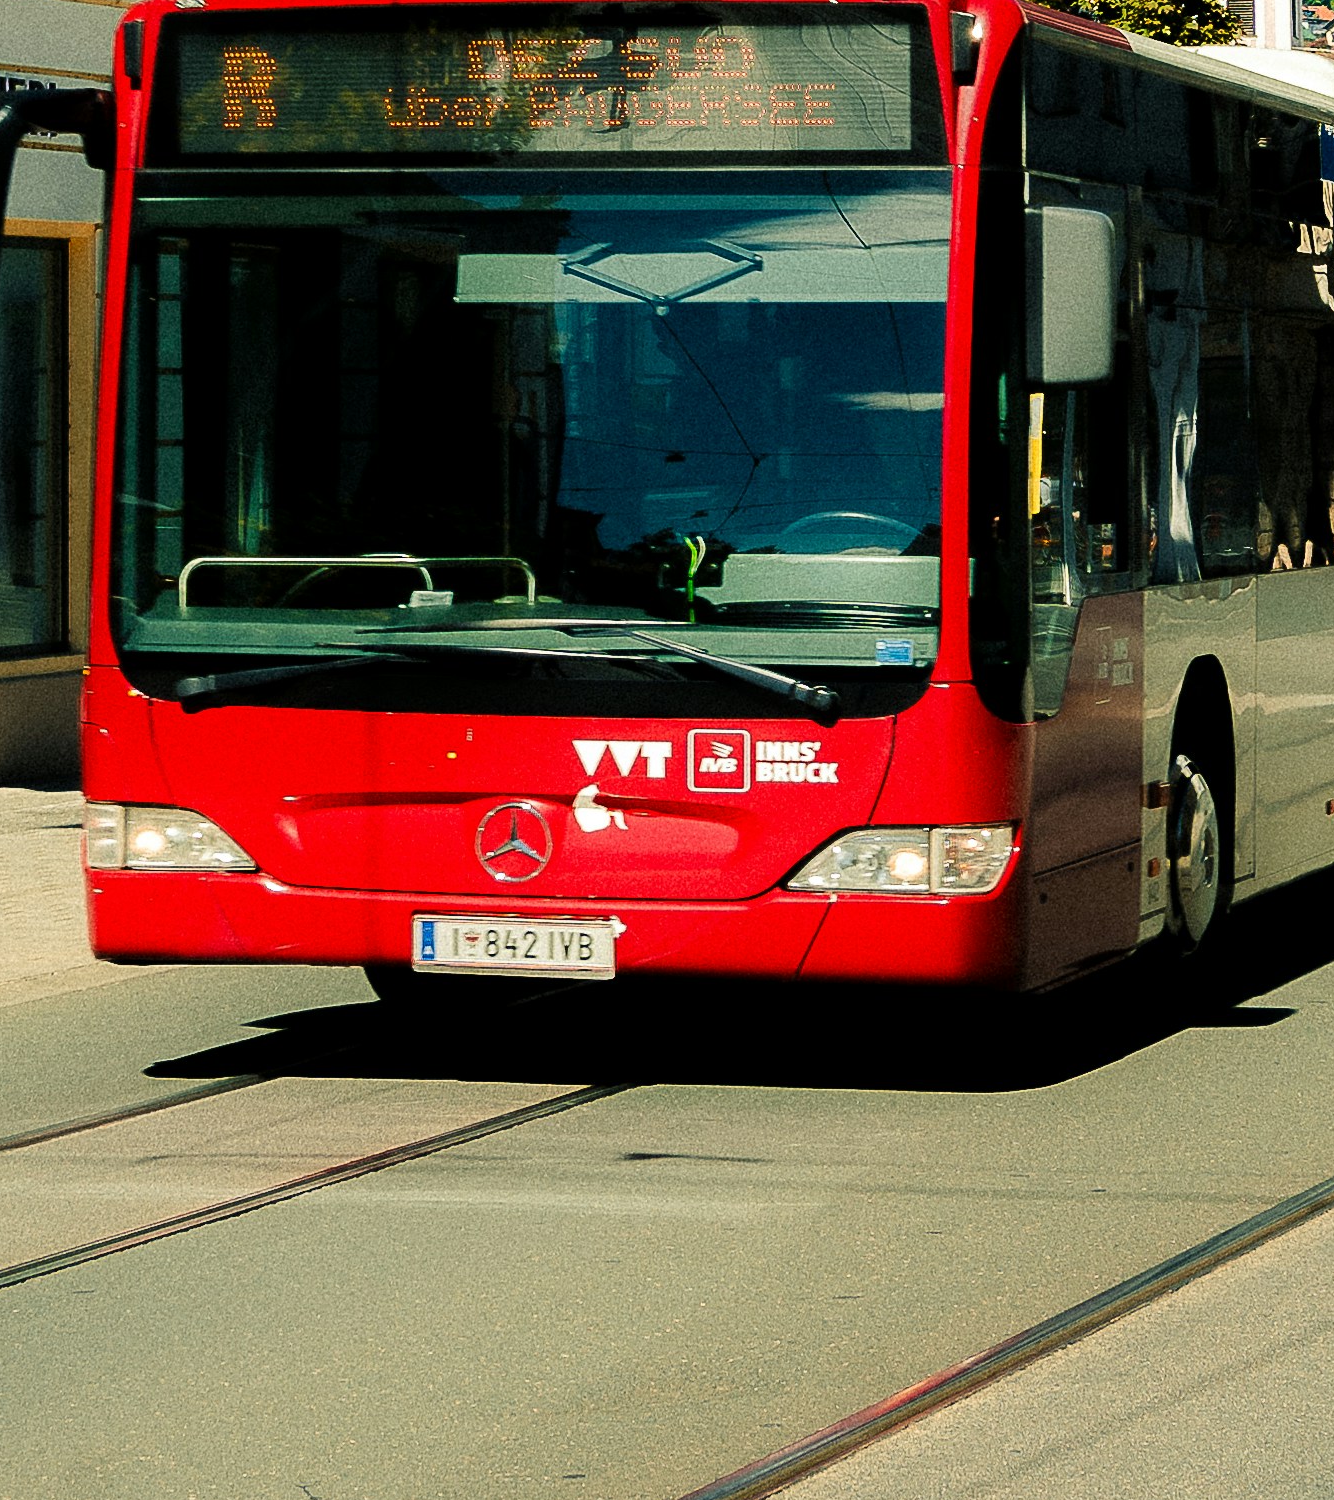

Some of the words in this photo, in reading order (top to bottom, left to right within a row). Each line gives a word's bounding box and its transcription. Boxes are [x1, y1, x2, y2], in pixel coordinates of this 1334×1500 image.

[468, 38, 602, 79] DEZ
[222, 45, 279, 129] R
[571, 739, 673, 779] VVT
[755, 762, 839, 784] BRUCK
